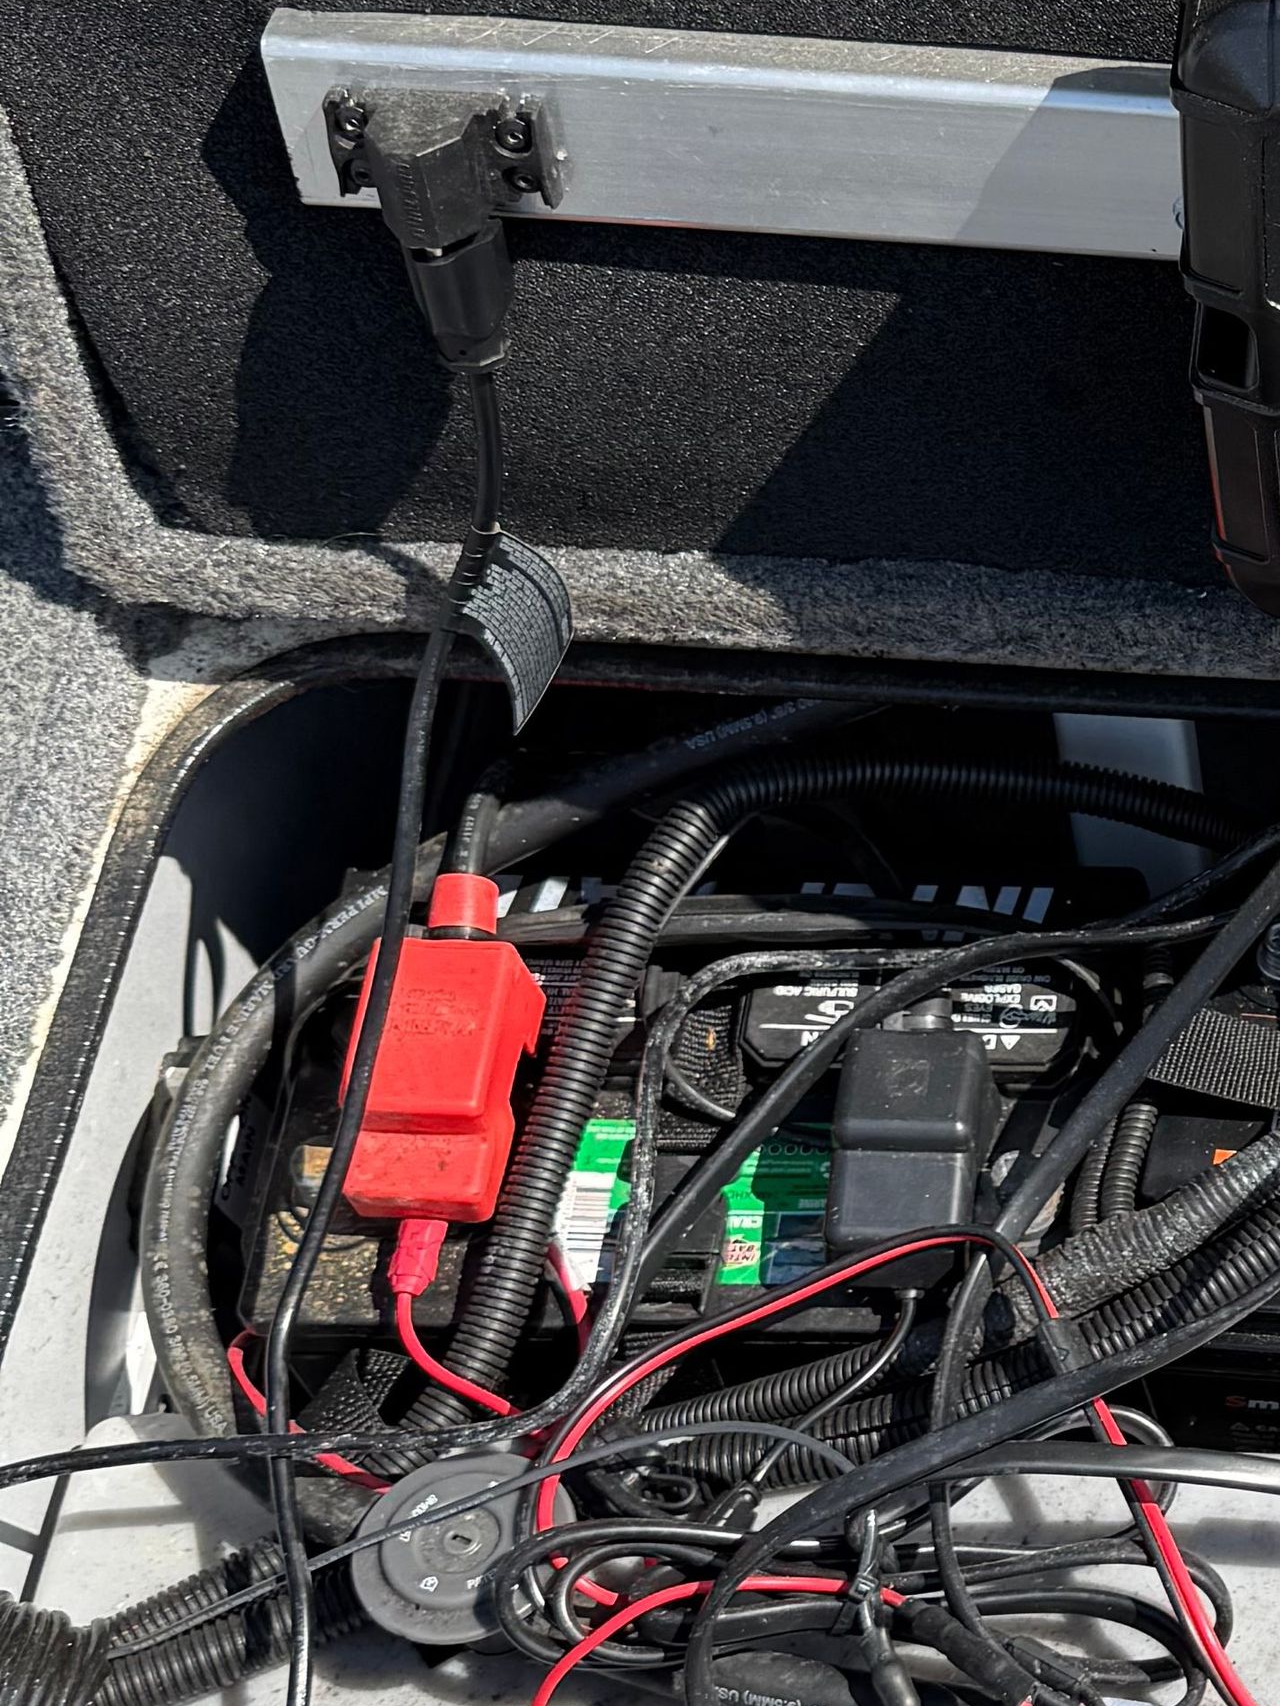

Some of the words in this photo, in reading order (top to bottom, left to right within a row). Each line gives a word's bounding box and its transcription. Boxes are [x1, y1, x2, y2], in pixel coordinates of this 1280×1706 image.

[684, 729, 717, 750] USA
[772, 985, 804, 997] ACID
[804, 986, 859, 997] SULFURIC
[960, 993, 1021, 1004] EXPLOSIVE
[225, 980, 274, 1036] MARINE
[202, 1403, 229, 1435] USA
[714, 1685, 740, 1702] US
